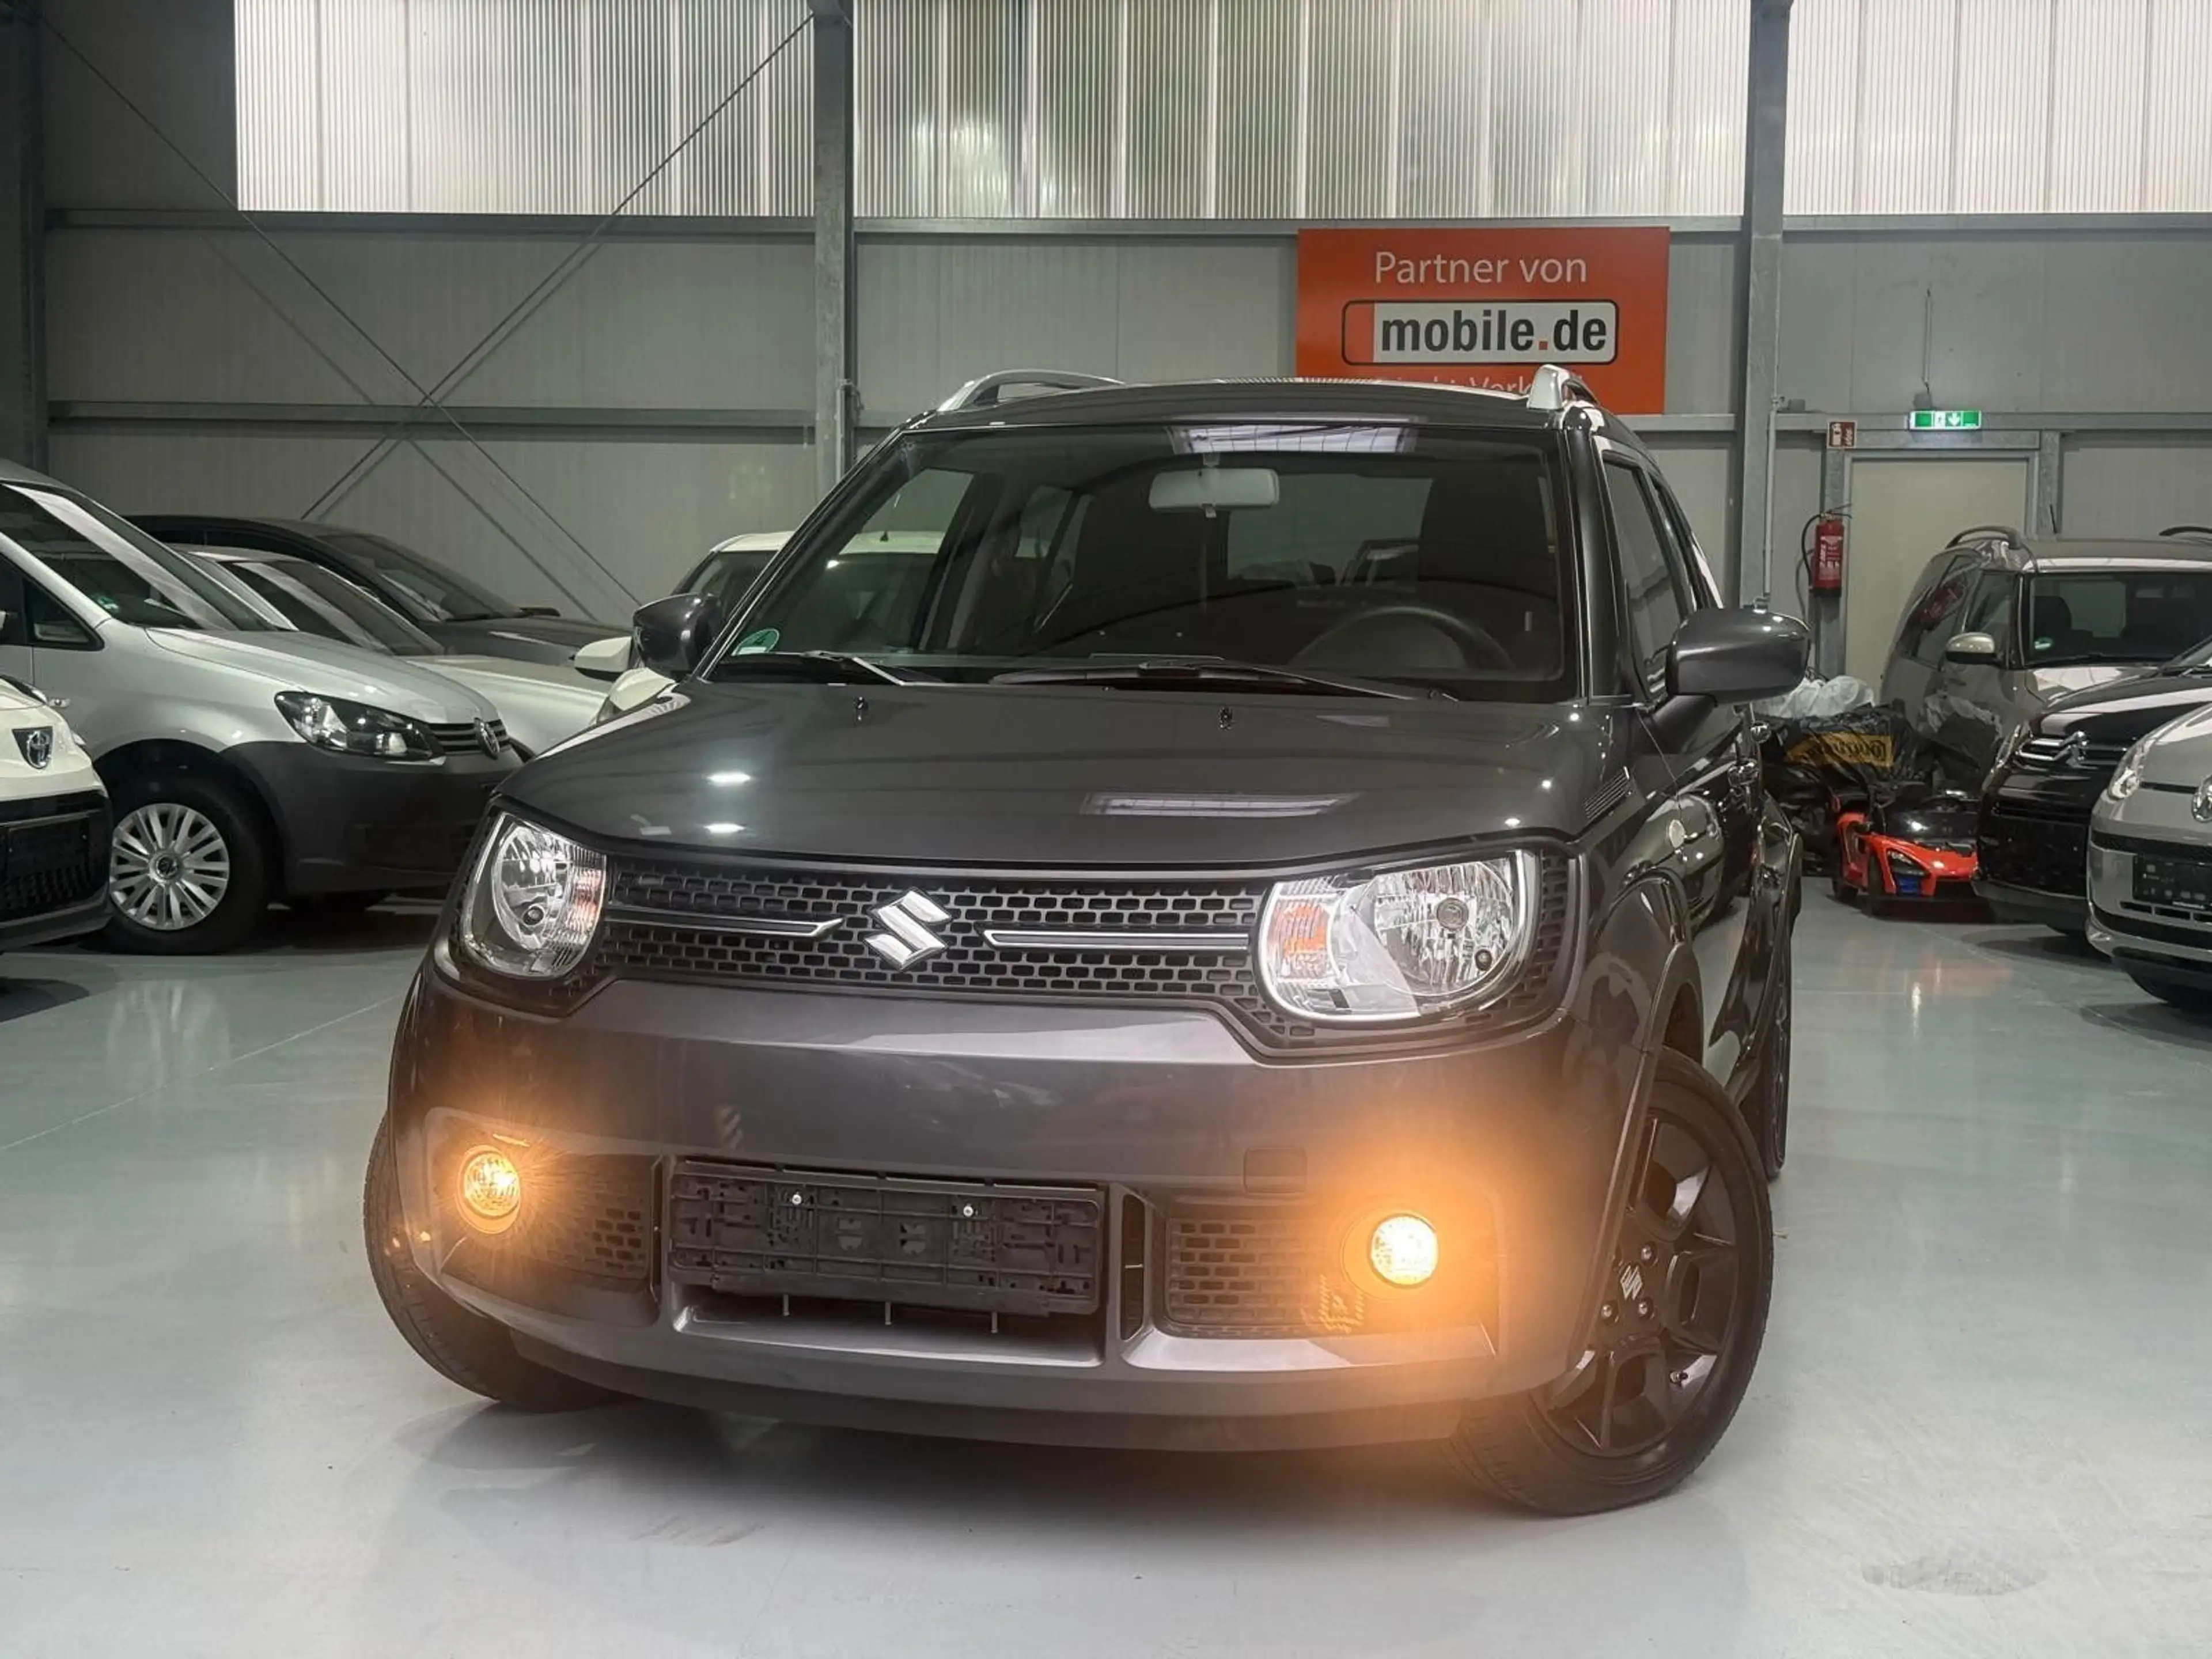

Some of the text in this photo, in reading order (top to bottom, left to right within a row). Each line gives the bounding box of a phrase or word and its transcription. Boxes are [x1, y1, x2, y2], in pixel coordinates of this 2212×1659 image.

[1375, 251, 1587, 283] Partner von
[1382, 309, 1607, 351] mobile.de
